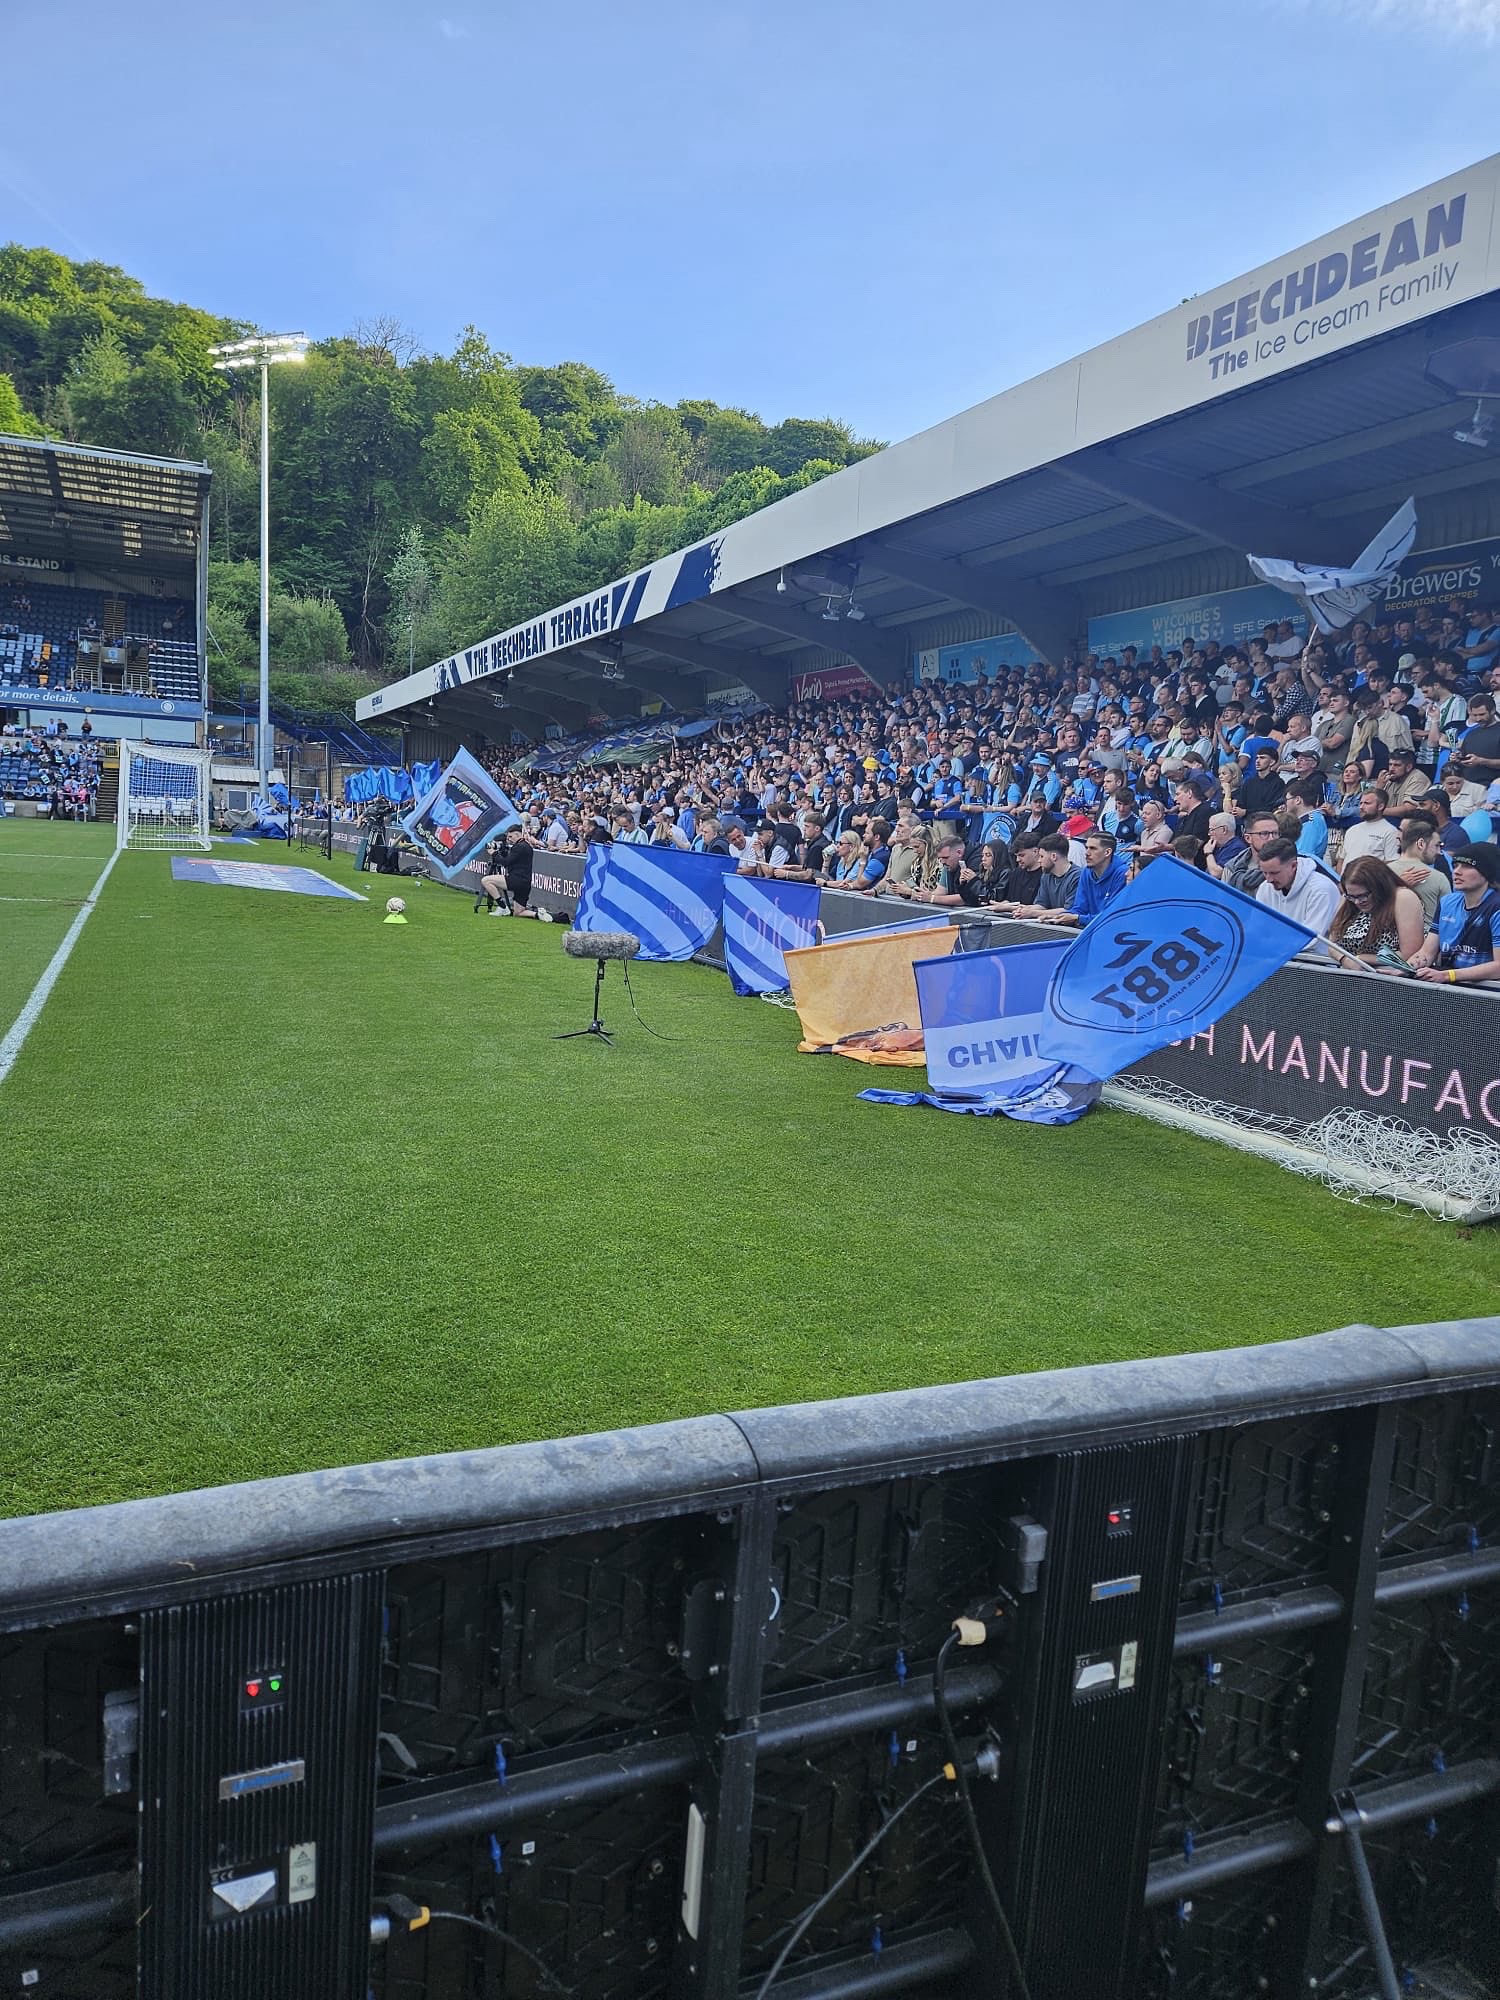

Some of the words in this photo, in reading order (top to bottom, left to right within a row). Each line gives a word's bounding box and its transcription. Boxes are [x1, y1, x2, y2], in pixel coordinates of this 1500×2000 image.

[1186, 192, 1467, 361] BEECHDEAN
[1208, 347, 1249, 380] The
[1255, 334, 1286, 363] Ice
[1293, 298, 1369, 345] Cream
[1378, 261, 1459, 313] Family
[16, 556, 60, 570] STAND
[1385, 566, 1482, 600] Brewers
[1385, 596, 1437, 612] DECORATOR
[473, 646, 488, 677] THE
[491, 621, 546, 670] BEECHDEAN
[551, 594, 609, 648] TERRACE
[1164, 622, 1210, 646] BALLS
[12, 691, 40, 700] more
[43, 692, 80, 704] details.
[531, 872, 562, 894] ARDWARE
